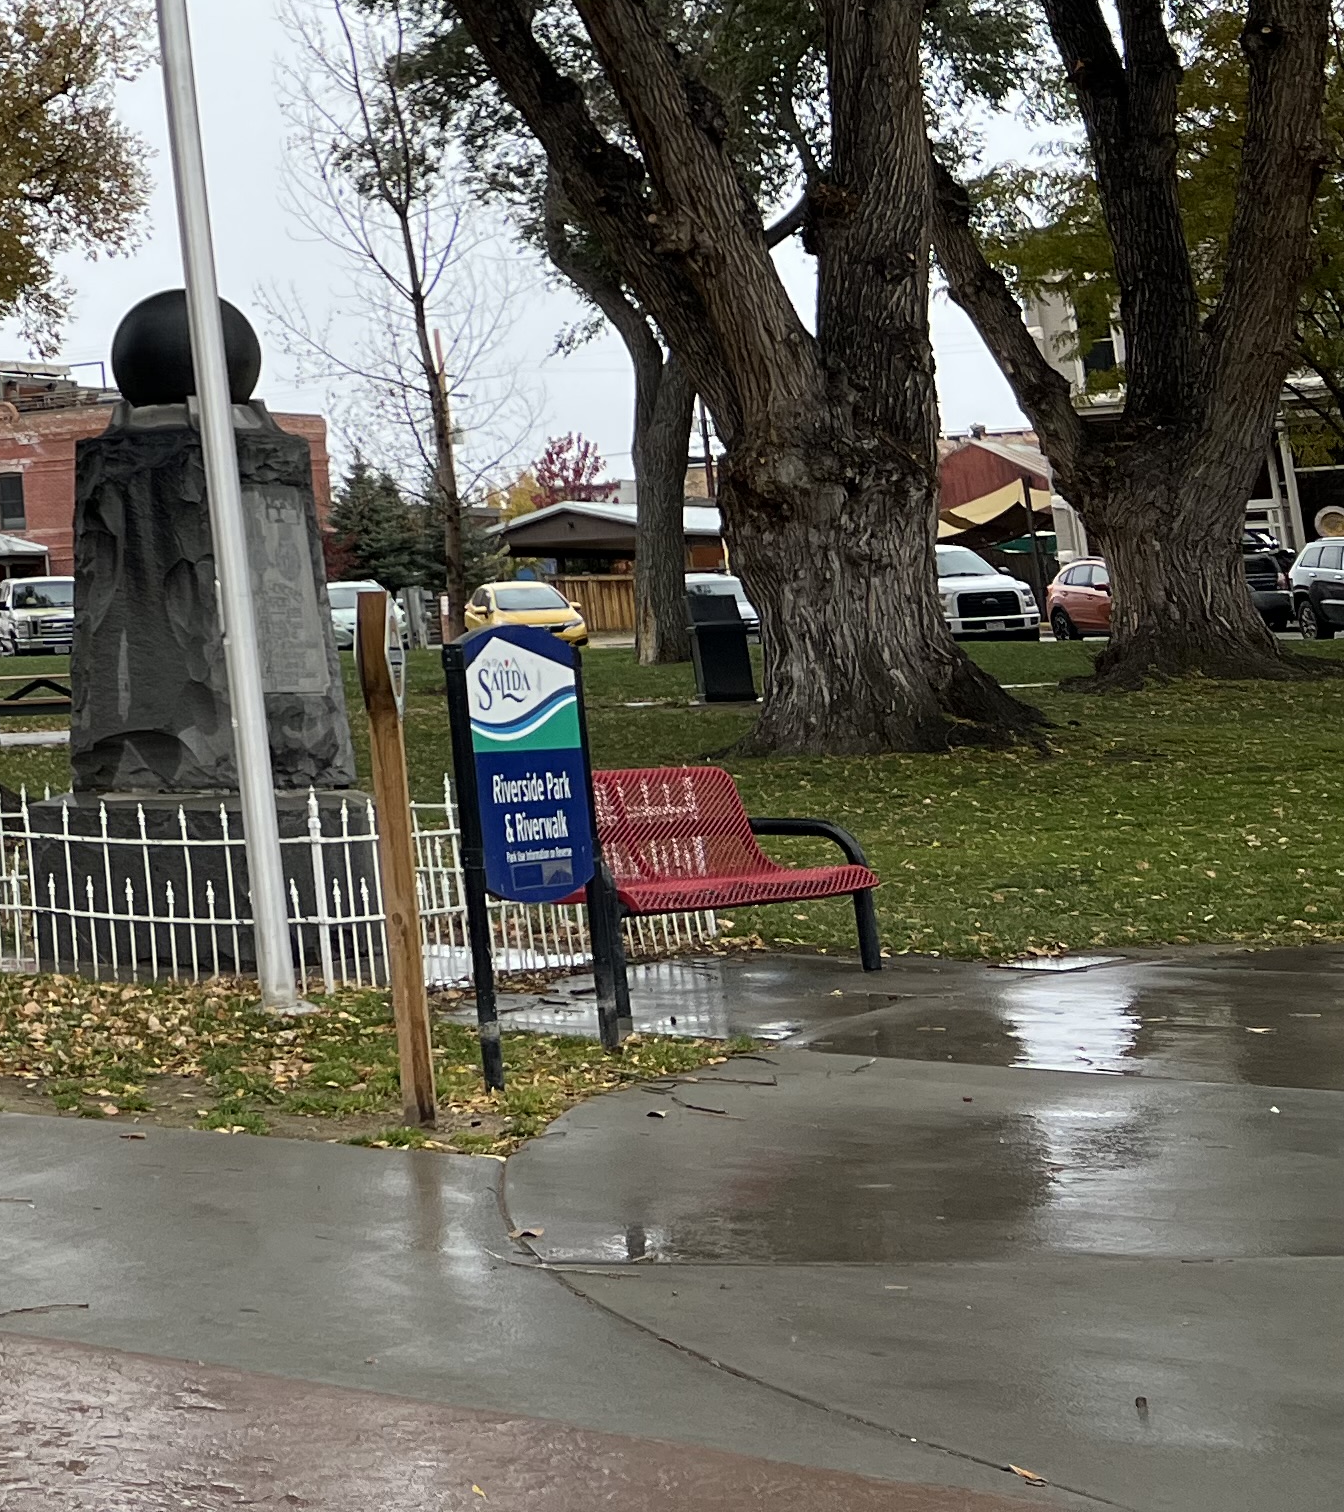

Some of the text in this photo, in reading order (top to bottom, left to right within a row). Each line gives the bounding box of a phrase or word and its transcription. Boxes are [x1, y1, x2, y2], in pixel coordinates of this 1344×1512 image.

[475, 668, 531, 711] SALIDA
[492, 770, 572, 804] Riverside Park
[504, 809, 569, 843] & Riverwalk
